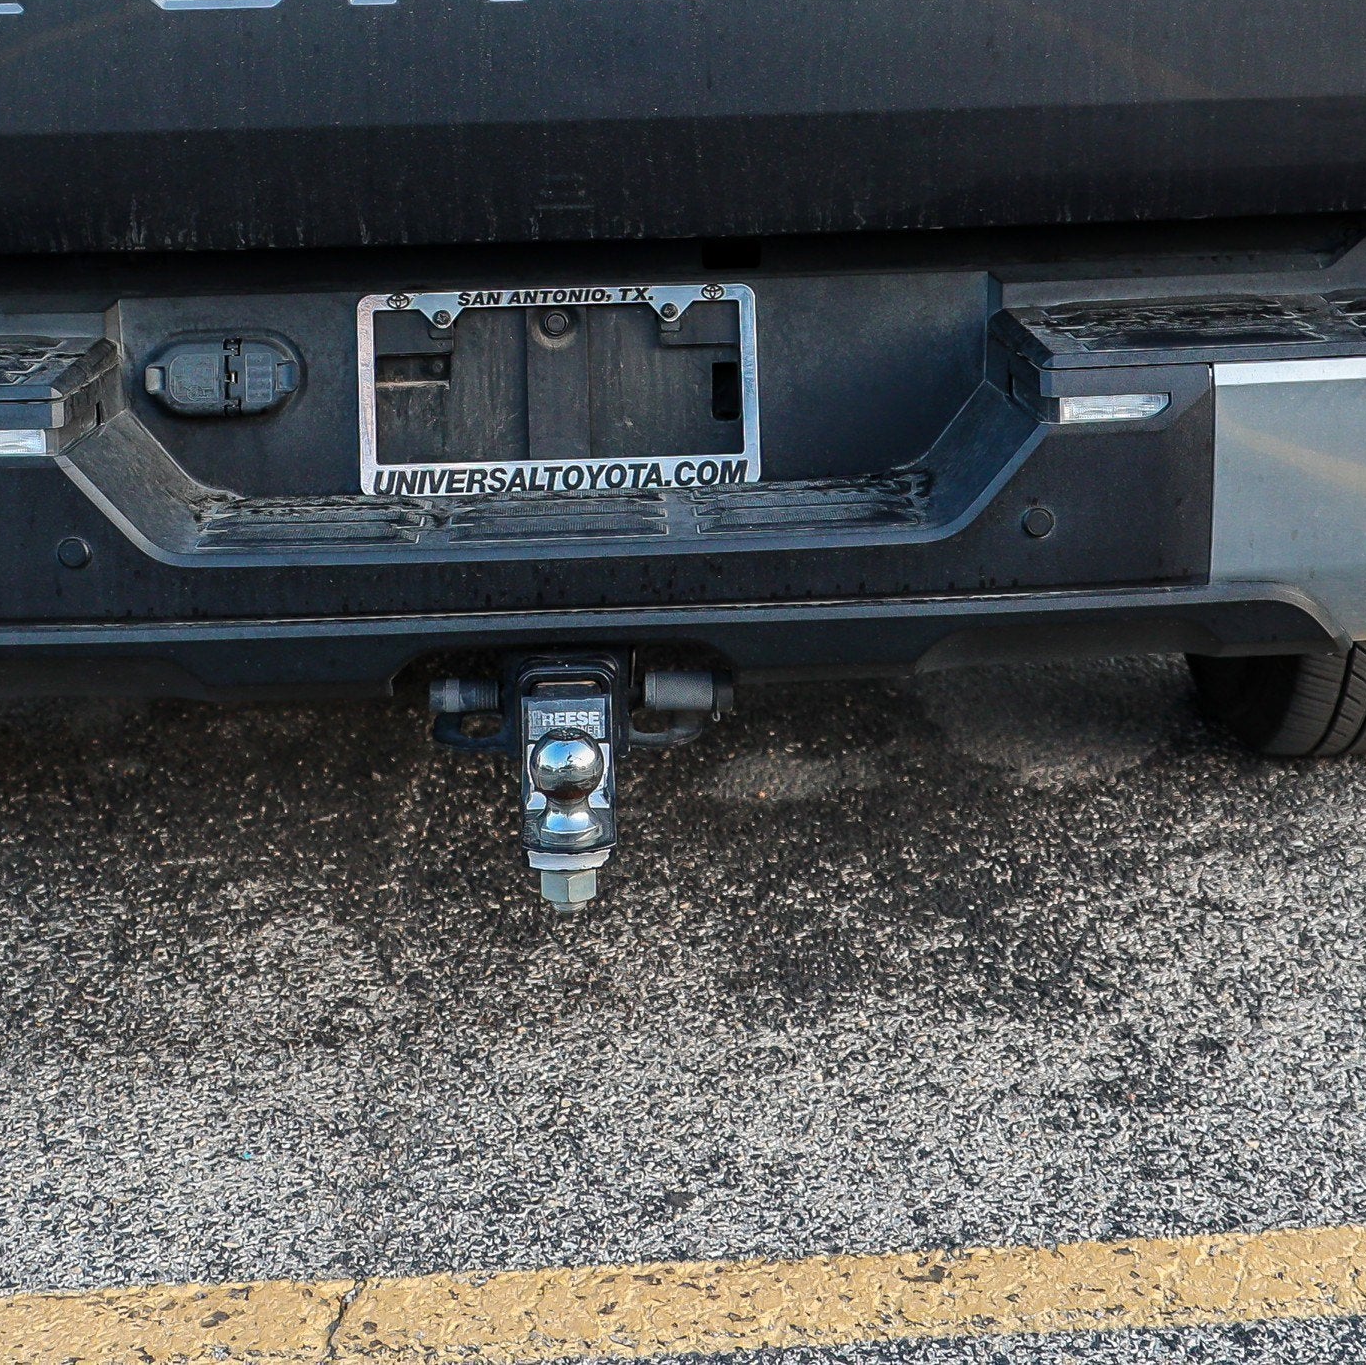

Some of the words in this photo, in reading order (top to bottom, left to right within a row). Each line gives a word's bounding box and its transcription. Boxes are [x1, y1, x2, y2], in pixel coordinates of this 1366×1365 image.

[457, 292, 503, 307] SAN
[507, 288, 612, 305] ANTONIO,
[618, 287, 654, 302] TX.
[373, 459, 749, 496] UNIVERSALTOYOTA.COM
[541, 711, 600, 726] REESE
